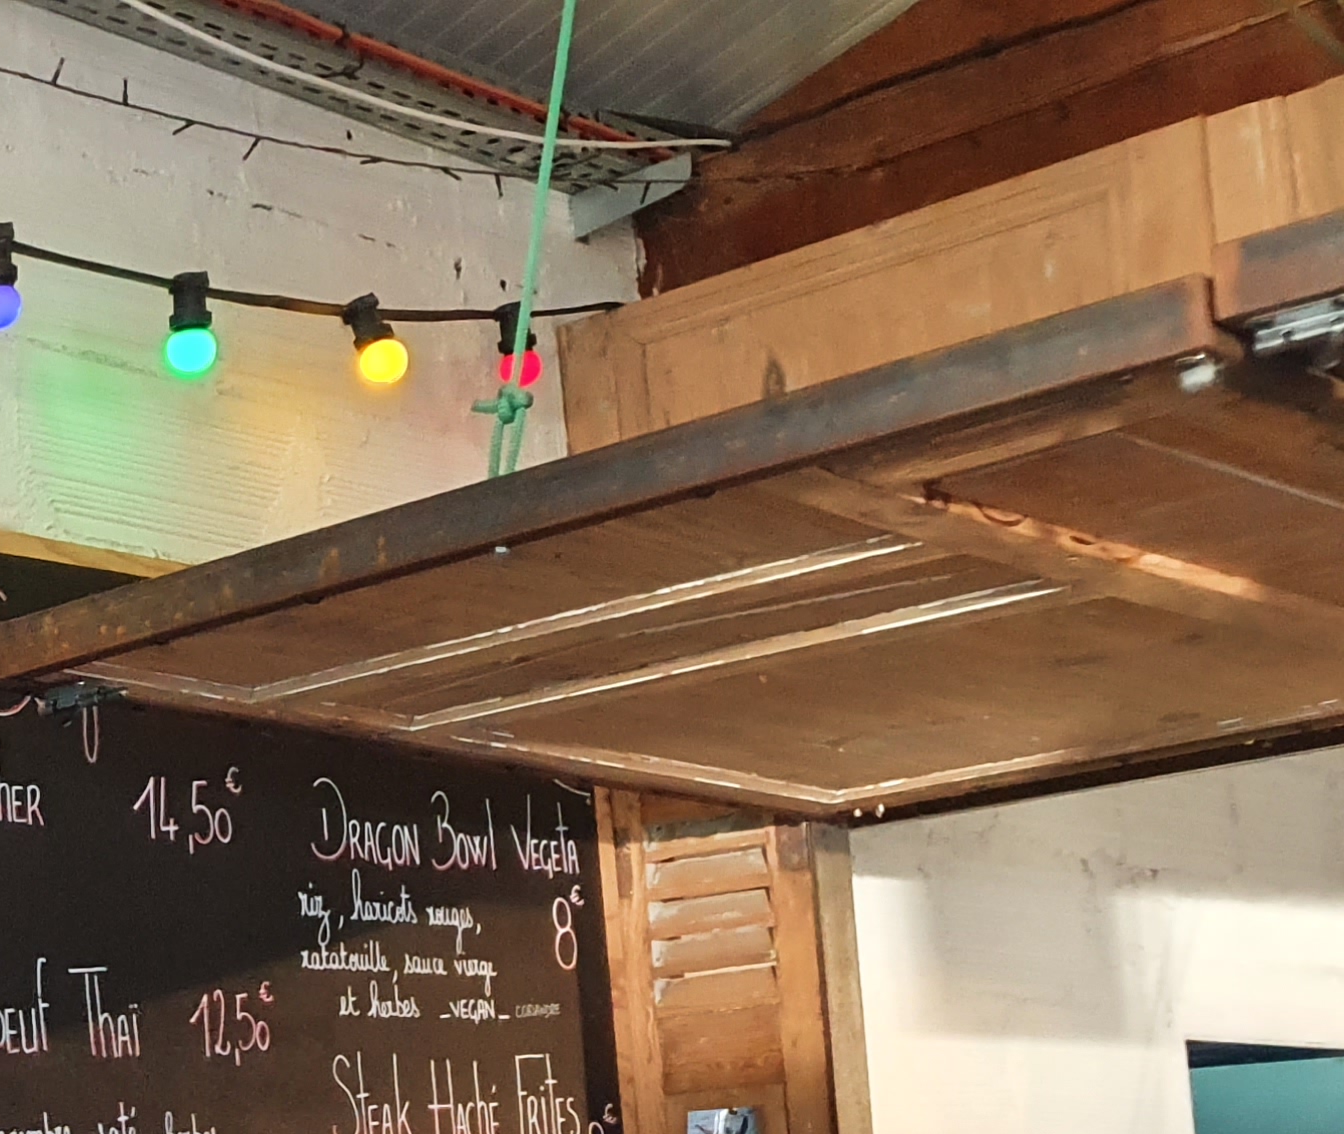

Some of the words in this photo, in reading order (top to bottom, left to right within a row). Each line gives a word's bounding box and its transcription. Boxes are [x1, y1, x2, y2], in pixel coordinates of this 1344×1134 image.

[350, 868, 417, 925] haricots
[404, 956, 447, 977] sauce
[339, 986, 360, 1018] et
[368, 981, 421, 1018] herbes
